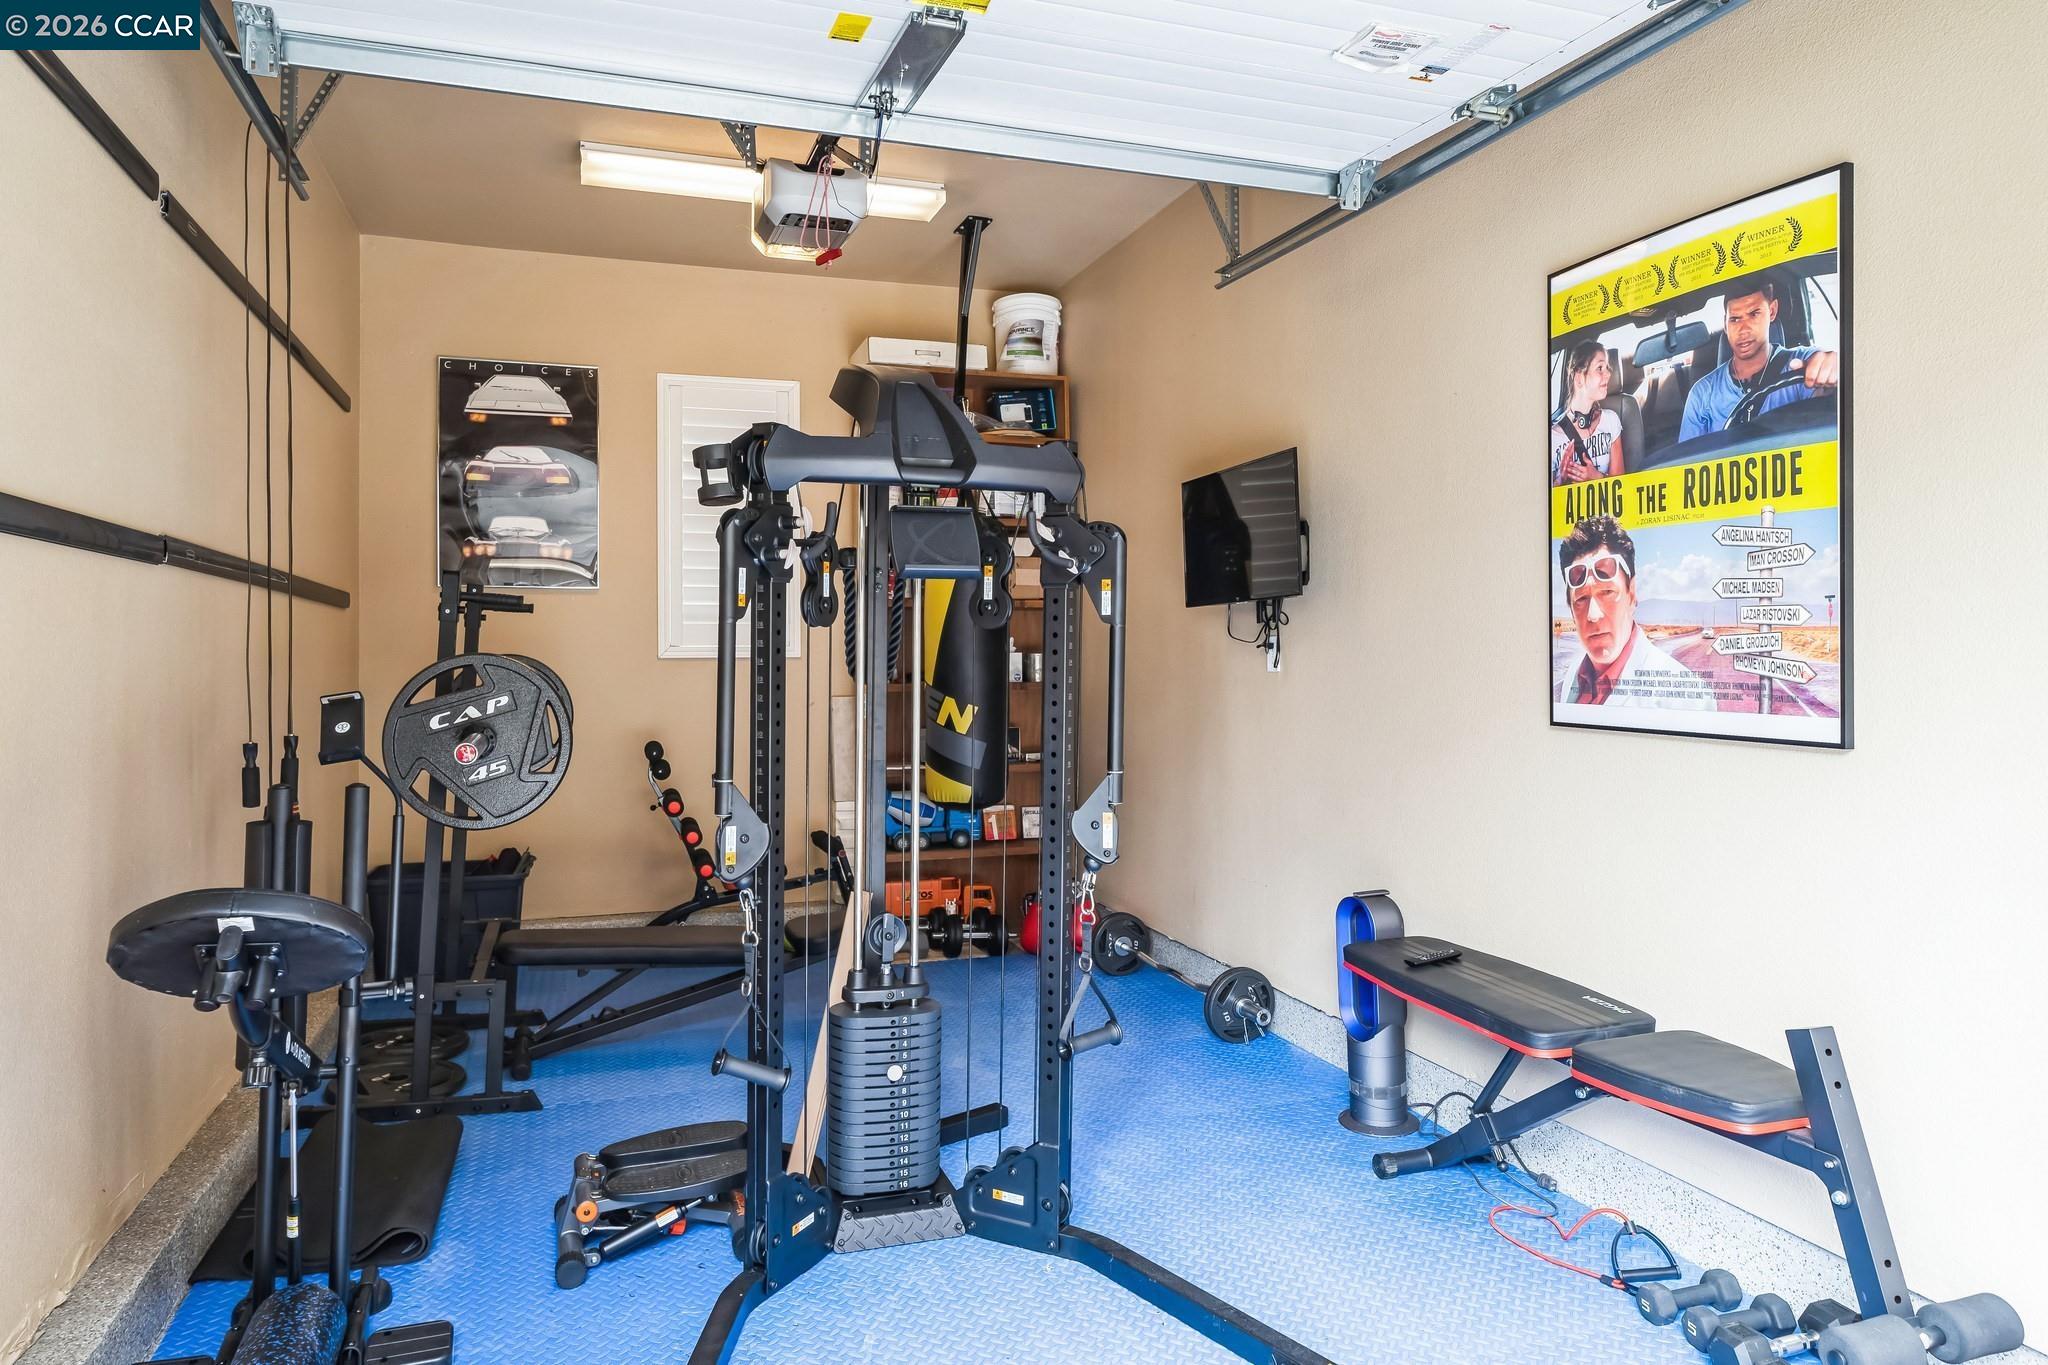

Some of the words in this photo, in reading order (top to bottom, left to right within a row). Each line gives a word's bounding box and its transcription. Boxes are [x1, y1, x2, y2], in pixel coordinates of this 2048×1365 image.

[1746, 224, 1786, 242] WINNER
[1680, 249, 1712, 265] WINNER
[1624, 271, 1652, 286] WINNER
[1572, 290, 1599, 304] WINNER
[444, 361, 594, 378] CHOICES
[1566, 479, 1623, 525] ALONG
[1636, 483, 1667, 515] THE
[1683, 450, 1803, 510] ROADSIDE
[1640, 517, 1661, 526] ZORAN
[1663, 514, 1690, 523] LISINAC
[1721, 529, 1754, 542] ANGELINA
[1755, 530, 1790, 544] HANTSCH
[1749, 553, 1766, 567] IMAN
[1767, 547, 1805, 565] CROSSON
[1721, 581, 1750, 594] MICHAEL
[1751, 581, 1780, 594] MADSEN
[1742, 608, 1761, 620] LAZAR
[1762, 608, 1800, 621] RISTOVSKI
[1720, 637, 1744, 651] DANIEL
[1746, 635, 1779, 649] GROZDICH
[1735, 654, 1766, 671] RHOMEYN
[1767, 660, 1804, 679] JOHNSON
[429, 695, 509, 731] CAP
[467, 759, 507, 783] 45
[988, 814, 999, 840] 1
[900, 990, 905, 998] 1
[902, 1016, 908, 1024] 2
[902, 1028, 908, 1036] 3
[902, 1063, 907, 1071] 6
[902, 1075, 907, 1083] 7
[901, 1087, 907, 1095] 8
[902, 1099, 907, 1107] 9
[900, 1122, 909, 1130] 11
[900, 1134, 909, 1142] 12
[900, 1157, 909, 1165] 14
[900, 1169, 909, 1177] 15
[1641, 1297, 1650, 1313] 5
[1687, 1320, 1697, 1337] 5
